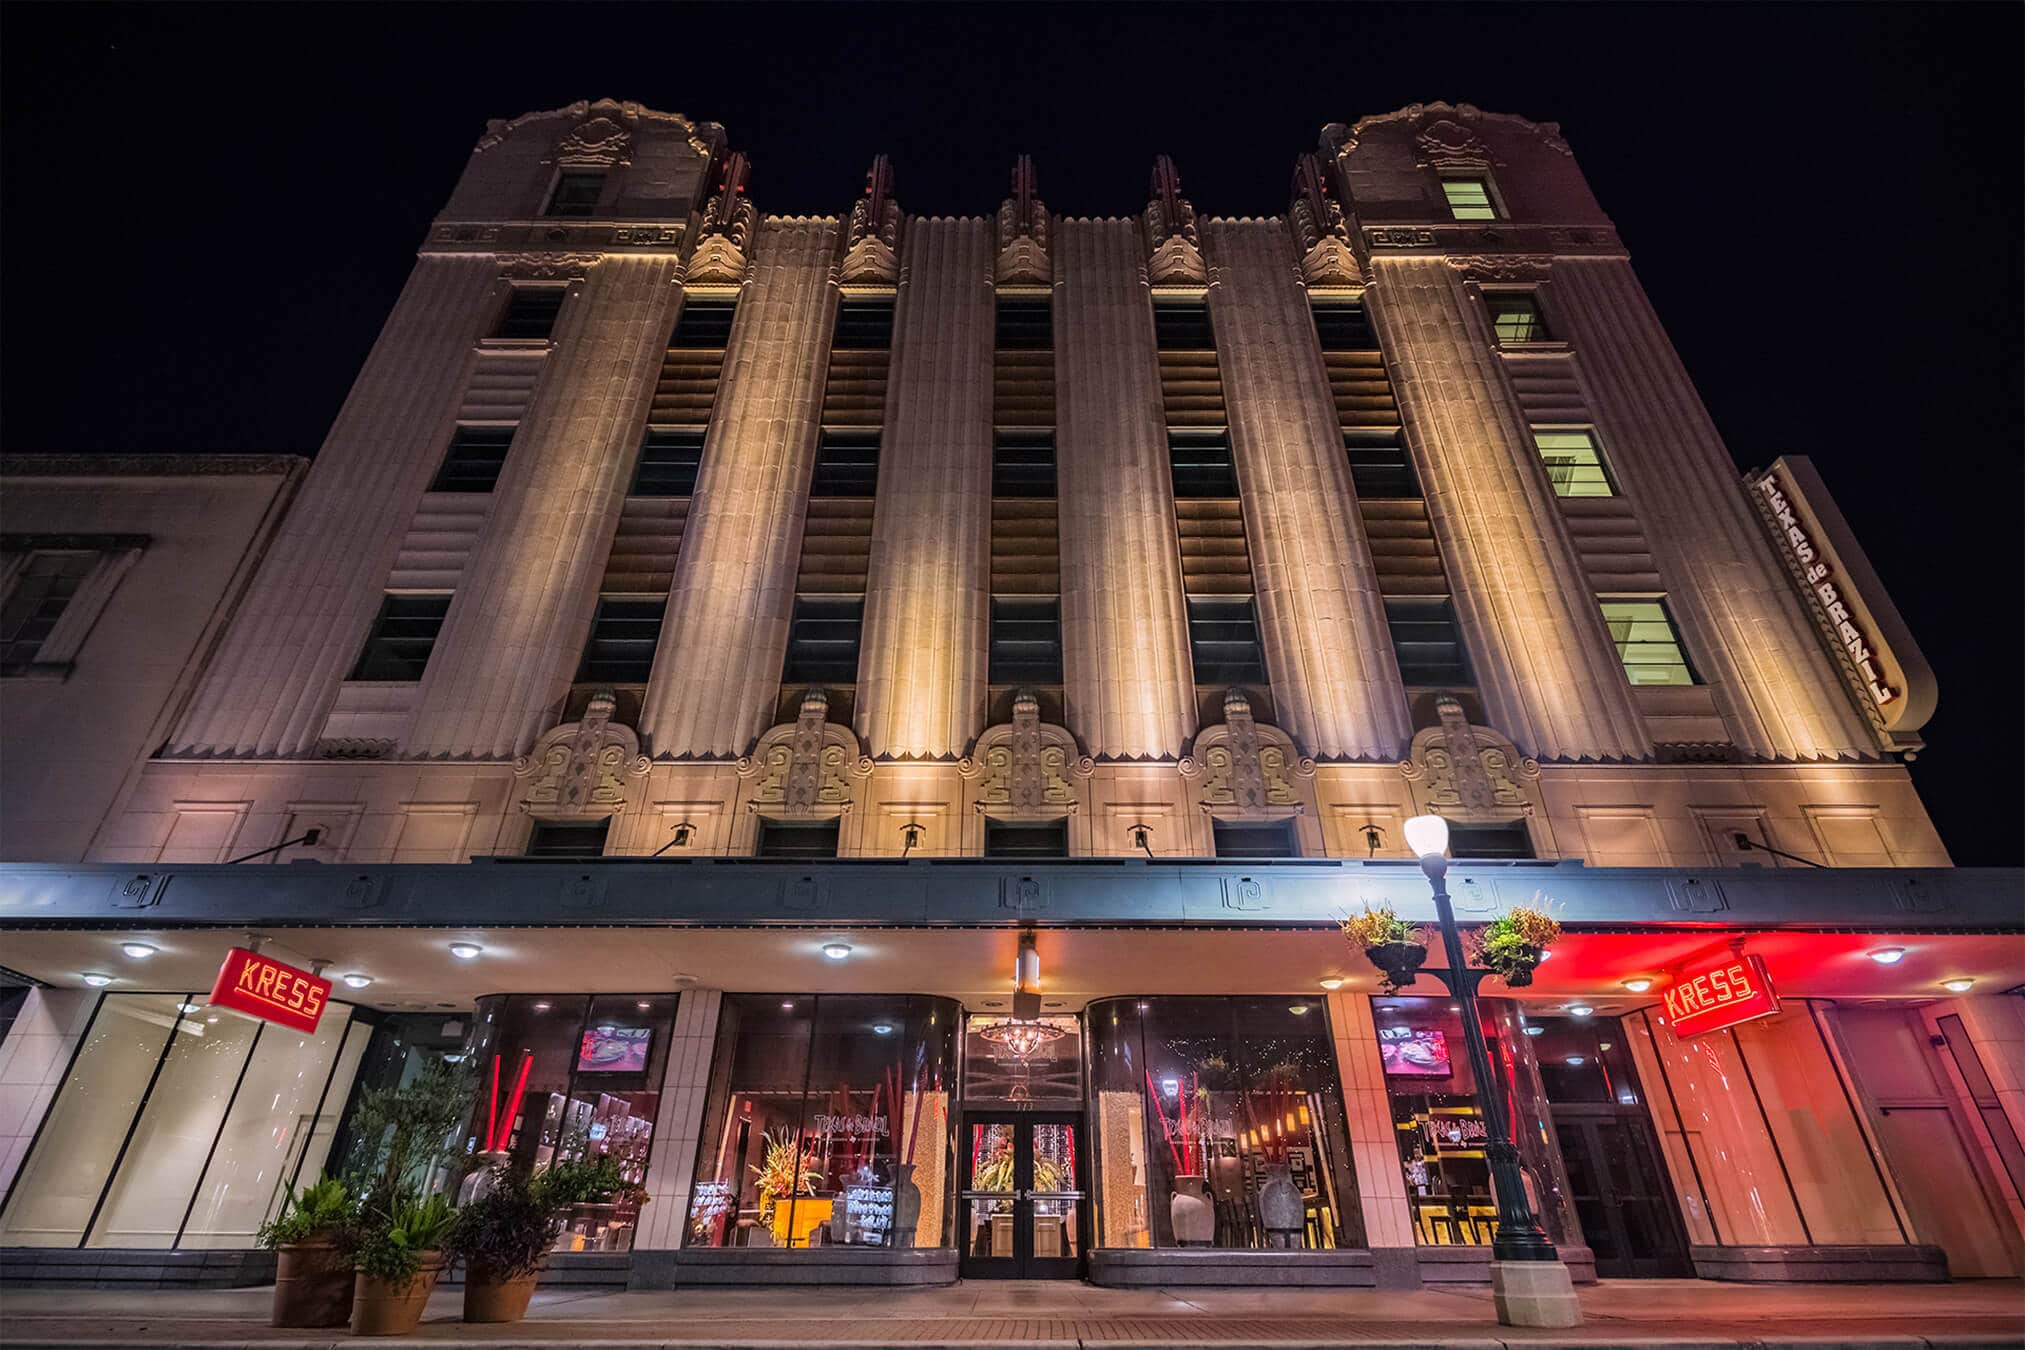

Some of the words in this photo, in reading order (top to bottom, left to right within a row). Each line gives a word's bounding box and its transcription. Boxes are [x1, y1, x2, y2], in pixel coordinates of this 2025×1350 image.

[1758, 475, 1814, 563] TEXAS
[1807, 563, 1828, 585] de
[1818, 583, 1894, 705] BRAZIL
[239, 958, 324, 1016] KRESS
[1663, 965, 1752, 1019] KRESS
